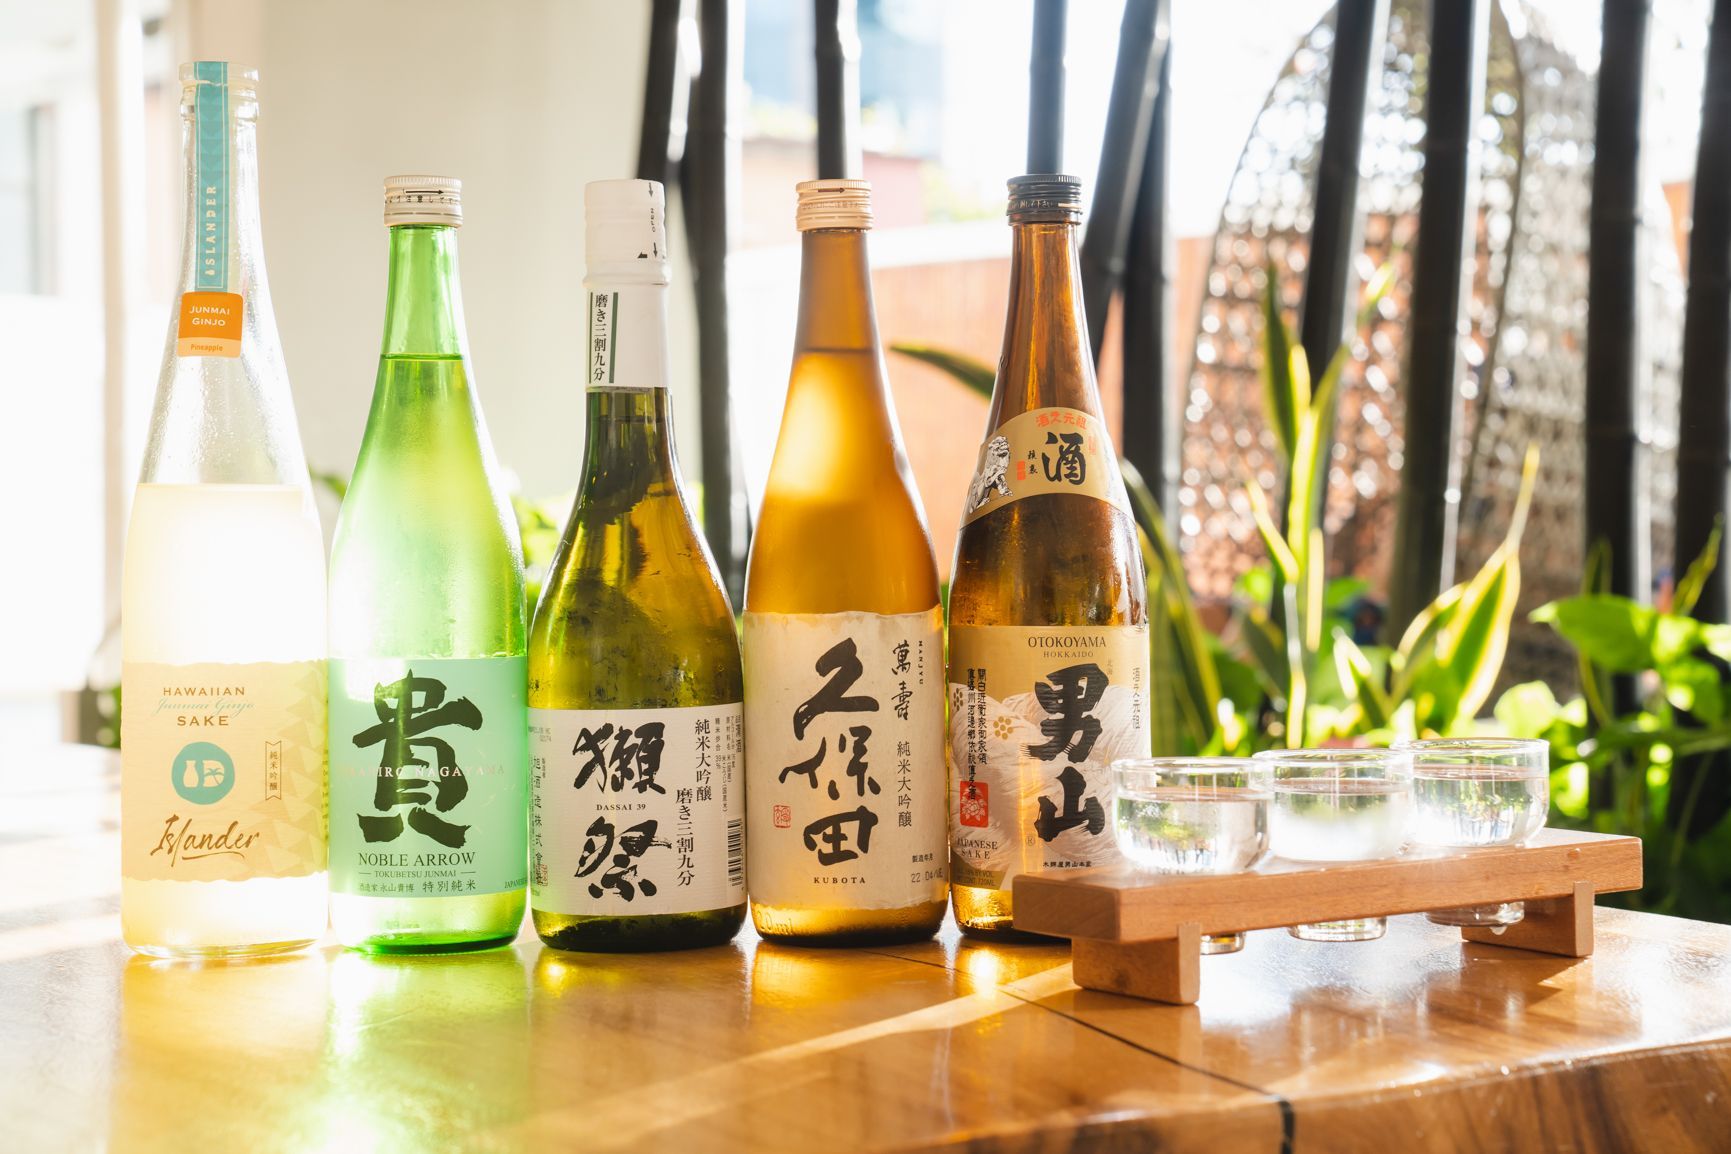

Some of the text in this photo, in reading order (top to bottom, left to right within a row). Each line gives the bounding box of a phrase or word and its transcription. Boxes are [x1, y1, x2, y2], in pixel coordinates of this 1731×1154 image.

[189, 306, 230, 315] JUNMAI
[192, 317, 226, 327] GINJO
[593, 293, 608, 381] 磨き三割九分
[190, 343, 224, 352] Pineapple
[1042, 431, 1086, 485] 酒
[1028, 636, 1107, 648] OTOKOYAMA
[1043, 650, 1094, 658] HOKKAIDO
[163, 687, 246, 697] HAWAIIAN
[176, 716, 230, 726] SAKE
[778, 637, 882, 866] 久保田
[1021, 663, 1109, 843] 男山
[352, 668, 483, 849] 貴
[695, 719, 712, 802] 純米大吟醸
[897, 741, 912, 827] 純米大吟醸
[596, 803, 647, 811] DASSAI 39
[150, 814, 260, 867] Islander
[676, 788, 695, 886] 磨き三割九分
[957, 837, 998, 850] JAPANESE
[358, 852, 476, 867] NOBLE ARROW
[961, 848, 990, 859] SAKE
[374, 870, 457, 878] TOKUBETSU JUNMAI
[422, 879, 476, 893] 特別純米
